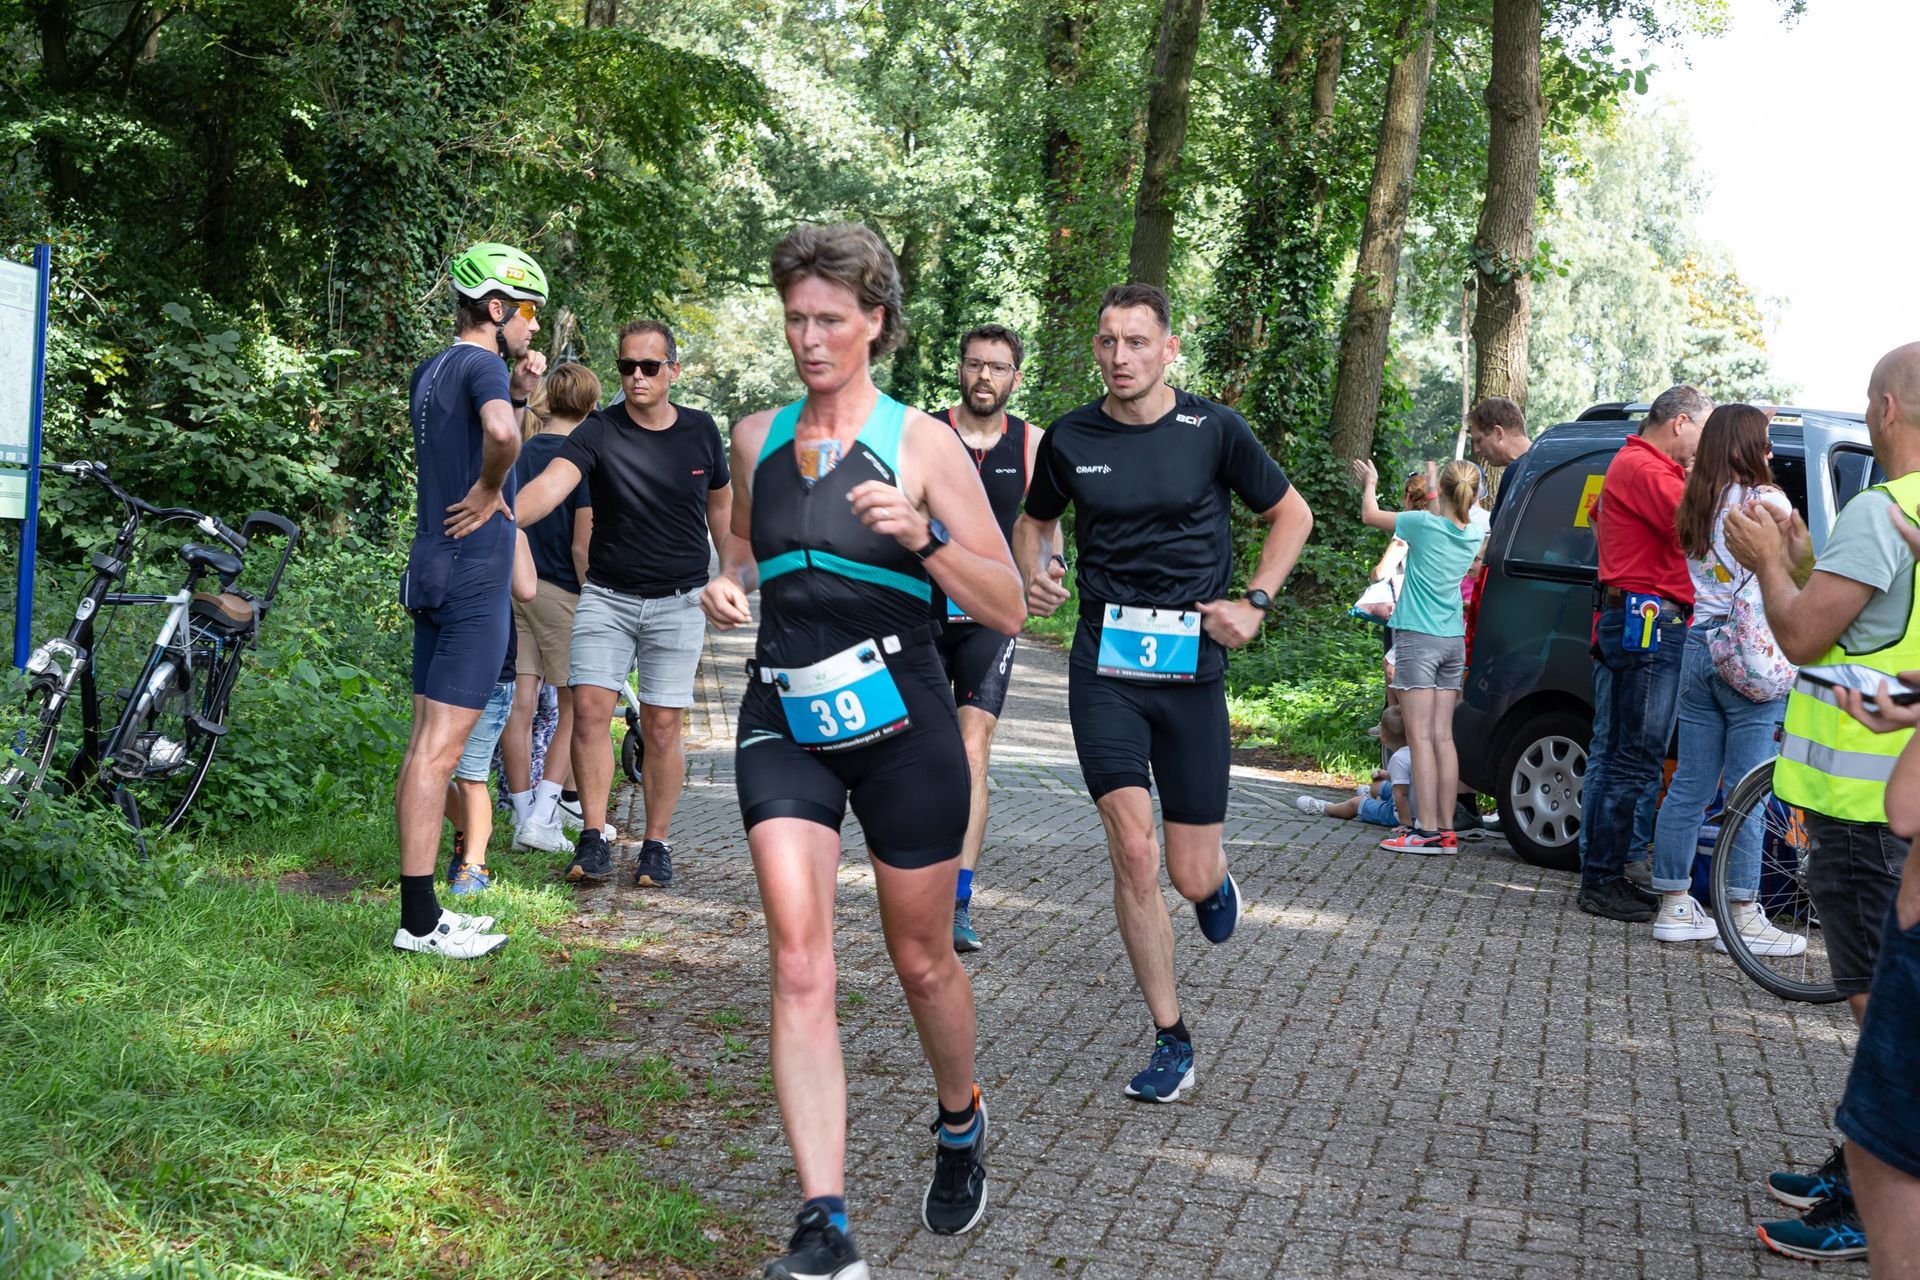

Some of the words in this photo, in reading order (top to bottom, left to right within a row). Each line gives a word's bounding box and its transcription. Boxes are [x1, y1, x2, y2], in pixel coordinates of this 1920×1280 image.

[1076, 465, 1103, 474] CRAFT
[999, 638, 1015, 675] orca
[1139, 636, 1158, 668] 3
[810, 690, 866, 737] 39
